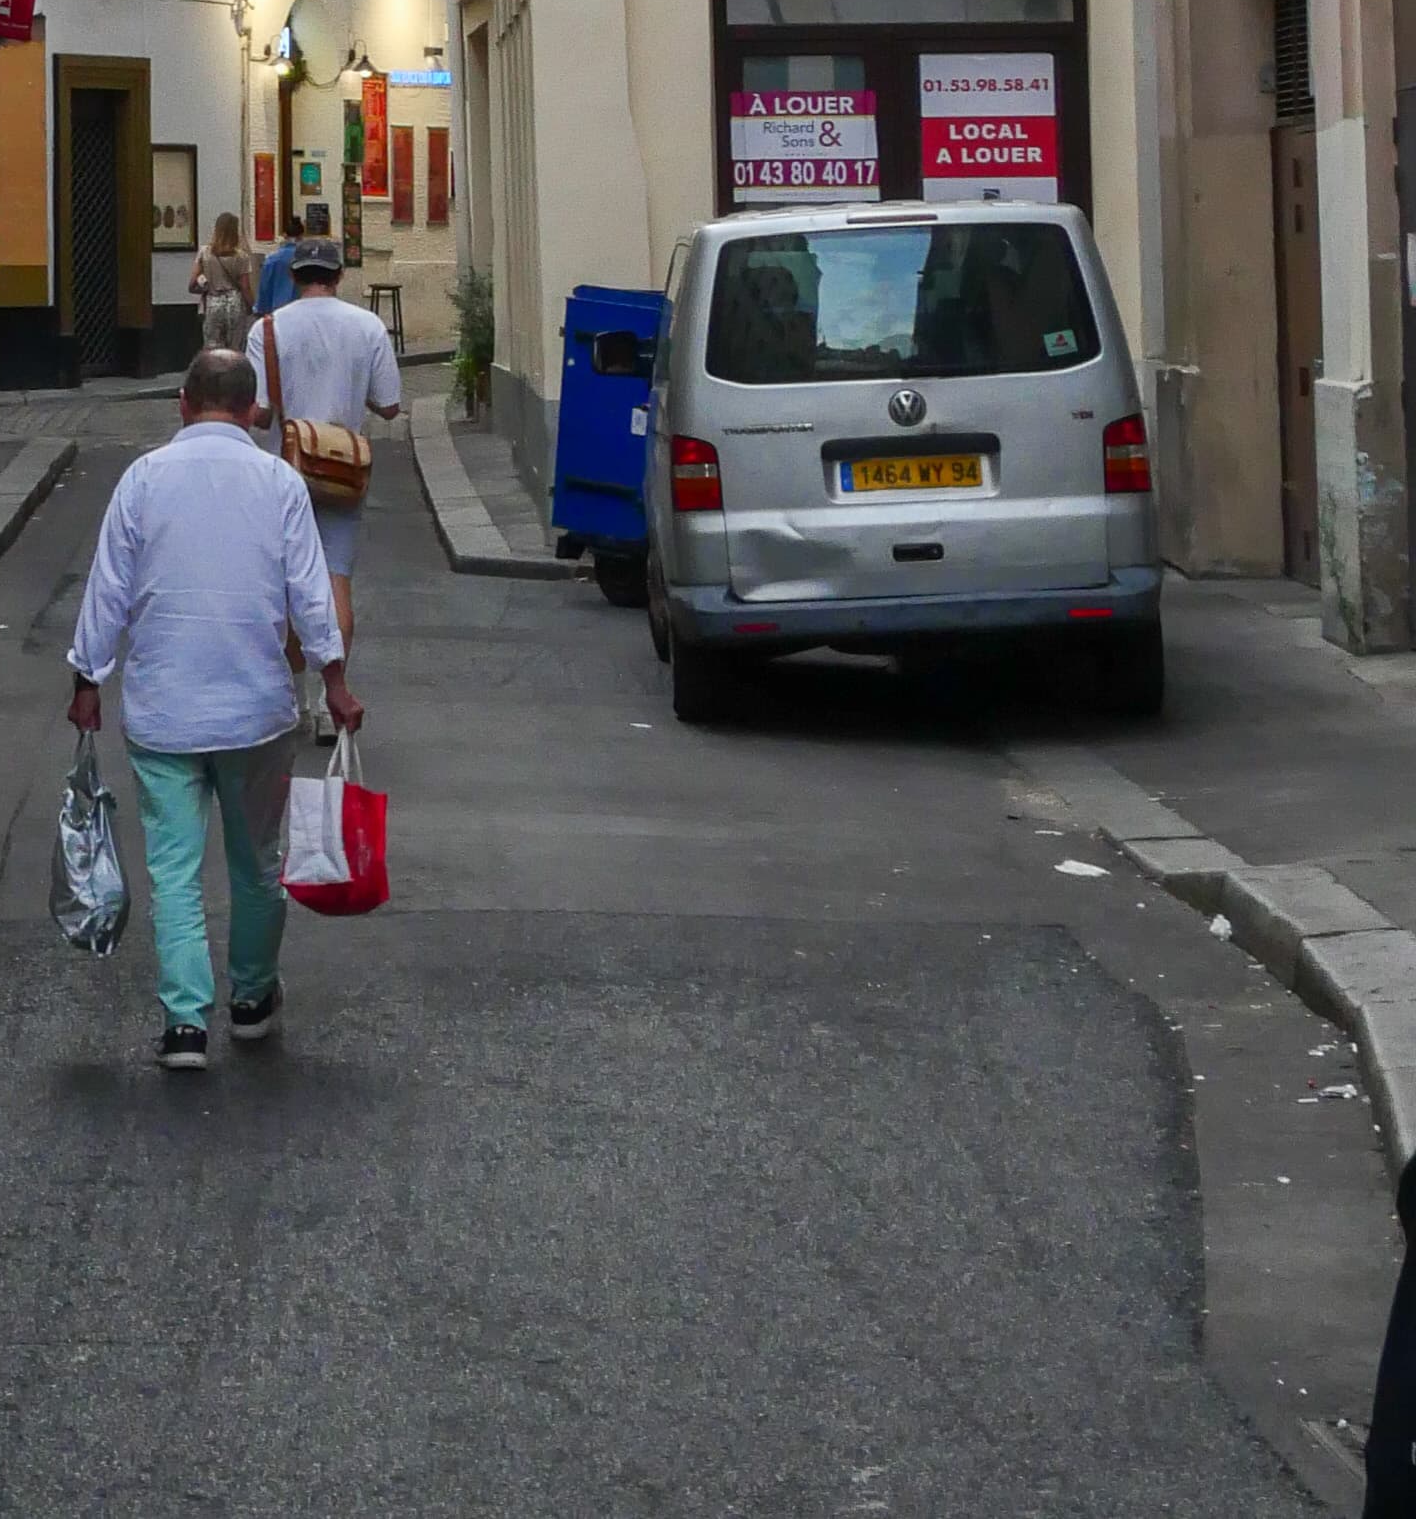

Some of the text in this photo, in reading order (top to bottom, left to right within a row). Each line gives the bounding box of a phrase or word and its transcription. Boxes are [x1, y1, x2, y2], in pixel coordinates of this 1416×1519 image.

[922, 78, 1050, 93] 01.53.98.58.41
[749, 93, 855, 115] À LOUER
[763, 120, 842, 147] Richard &
[949, 123, 1029, 140] LOCAL
[781, 135, 815, 148] Sons
[936, 147, 1043, 164] A LOUER
[734, 161, 876, 185] 01 43 80 40 17
[860, 462, 978, 485] 1464 WY 94
